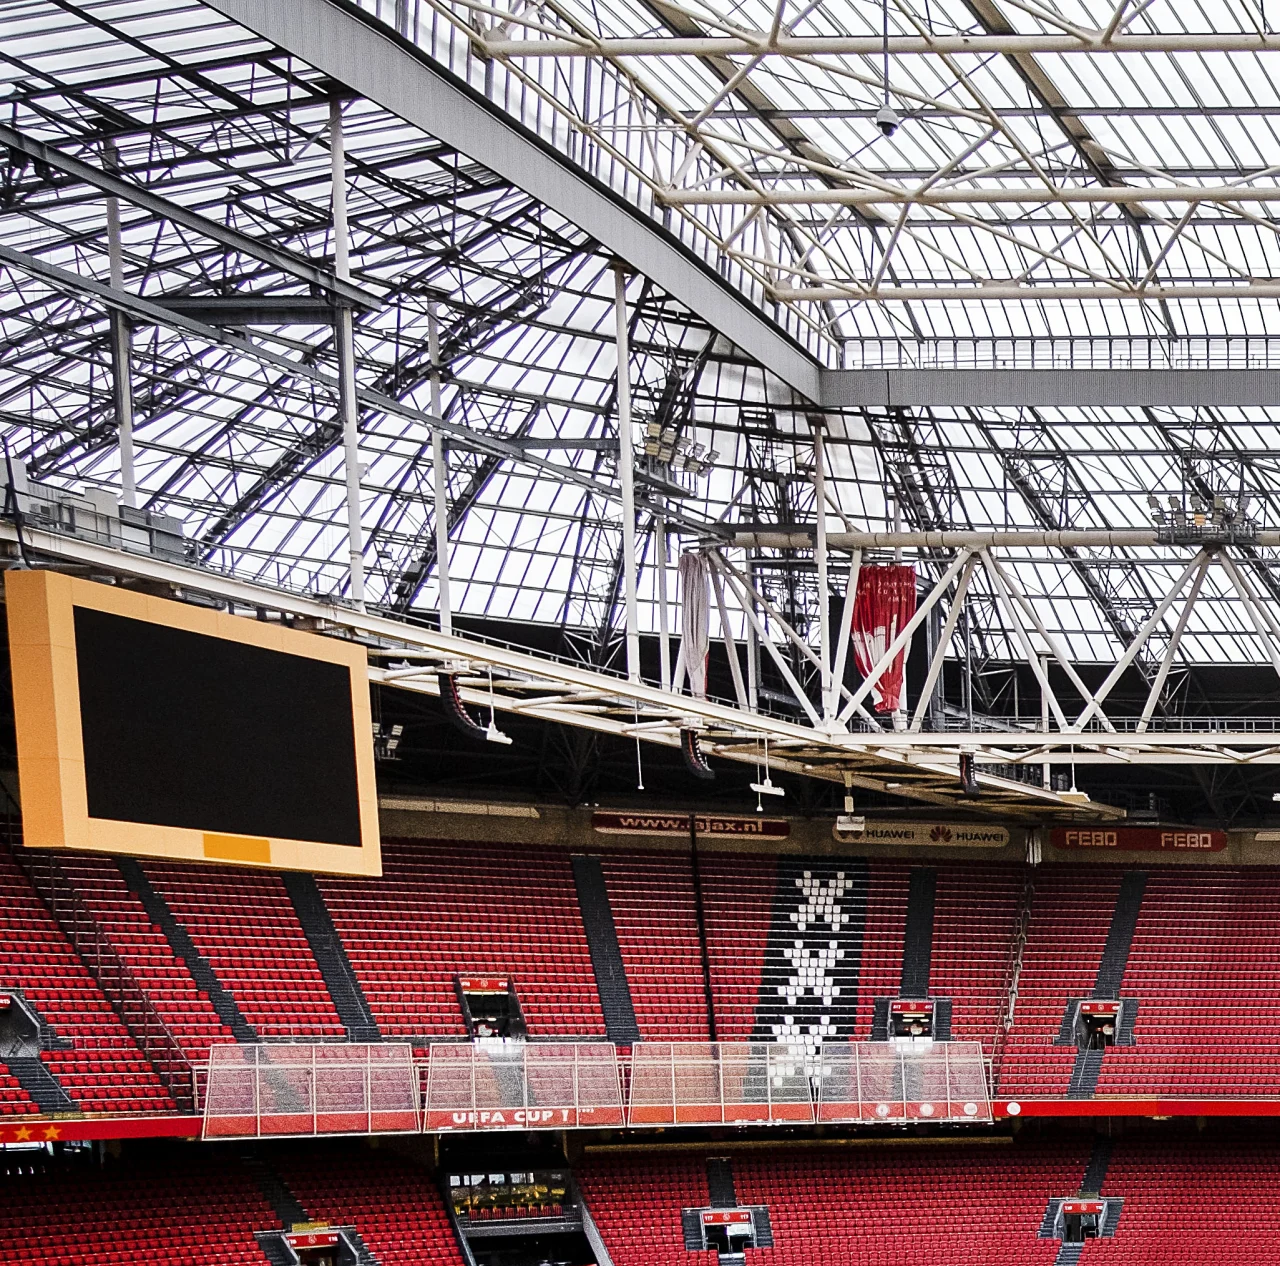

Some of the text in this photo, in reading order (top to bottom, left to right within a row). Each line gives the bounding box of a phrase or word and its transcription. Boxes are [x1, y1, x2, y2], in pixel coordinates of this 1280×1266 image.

[866, 830, 915, 840] HUAWEI
[956, 833, 1004, 843] HUAWEI
[1065, 831, 1118, 847] FEBO
[1160, 832, 1212, 848] FEBO
[452, 1110, 554, 1124] UEFA CUP
